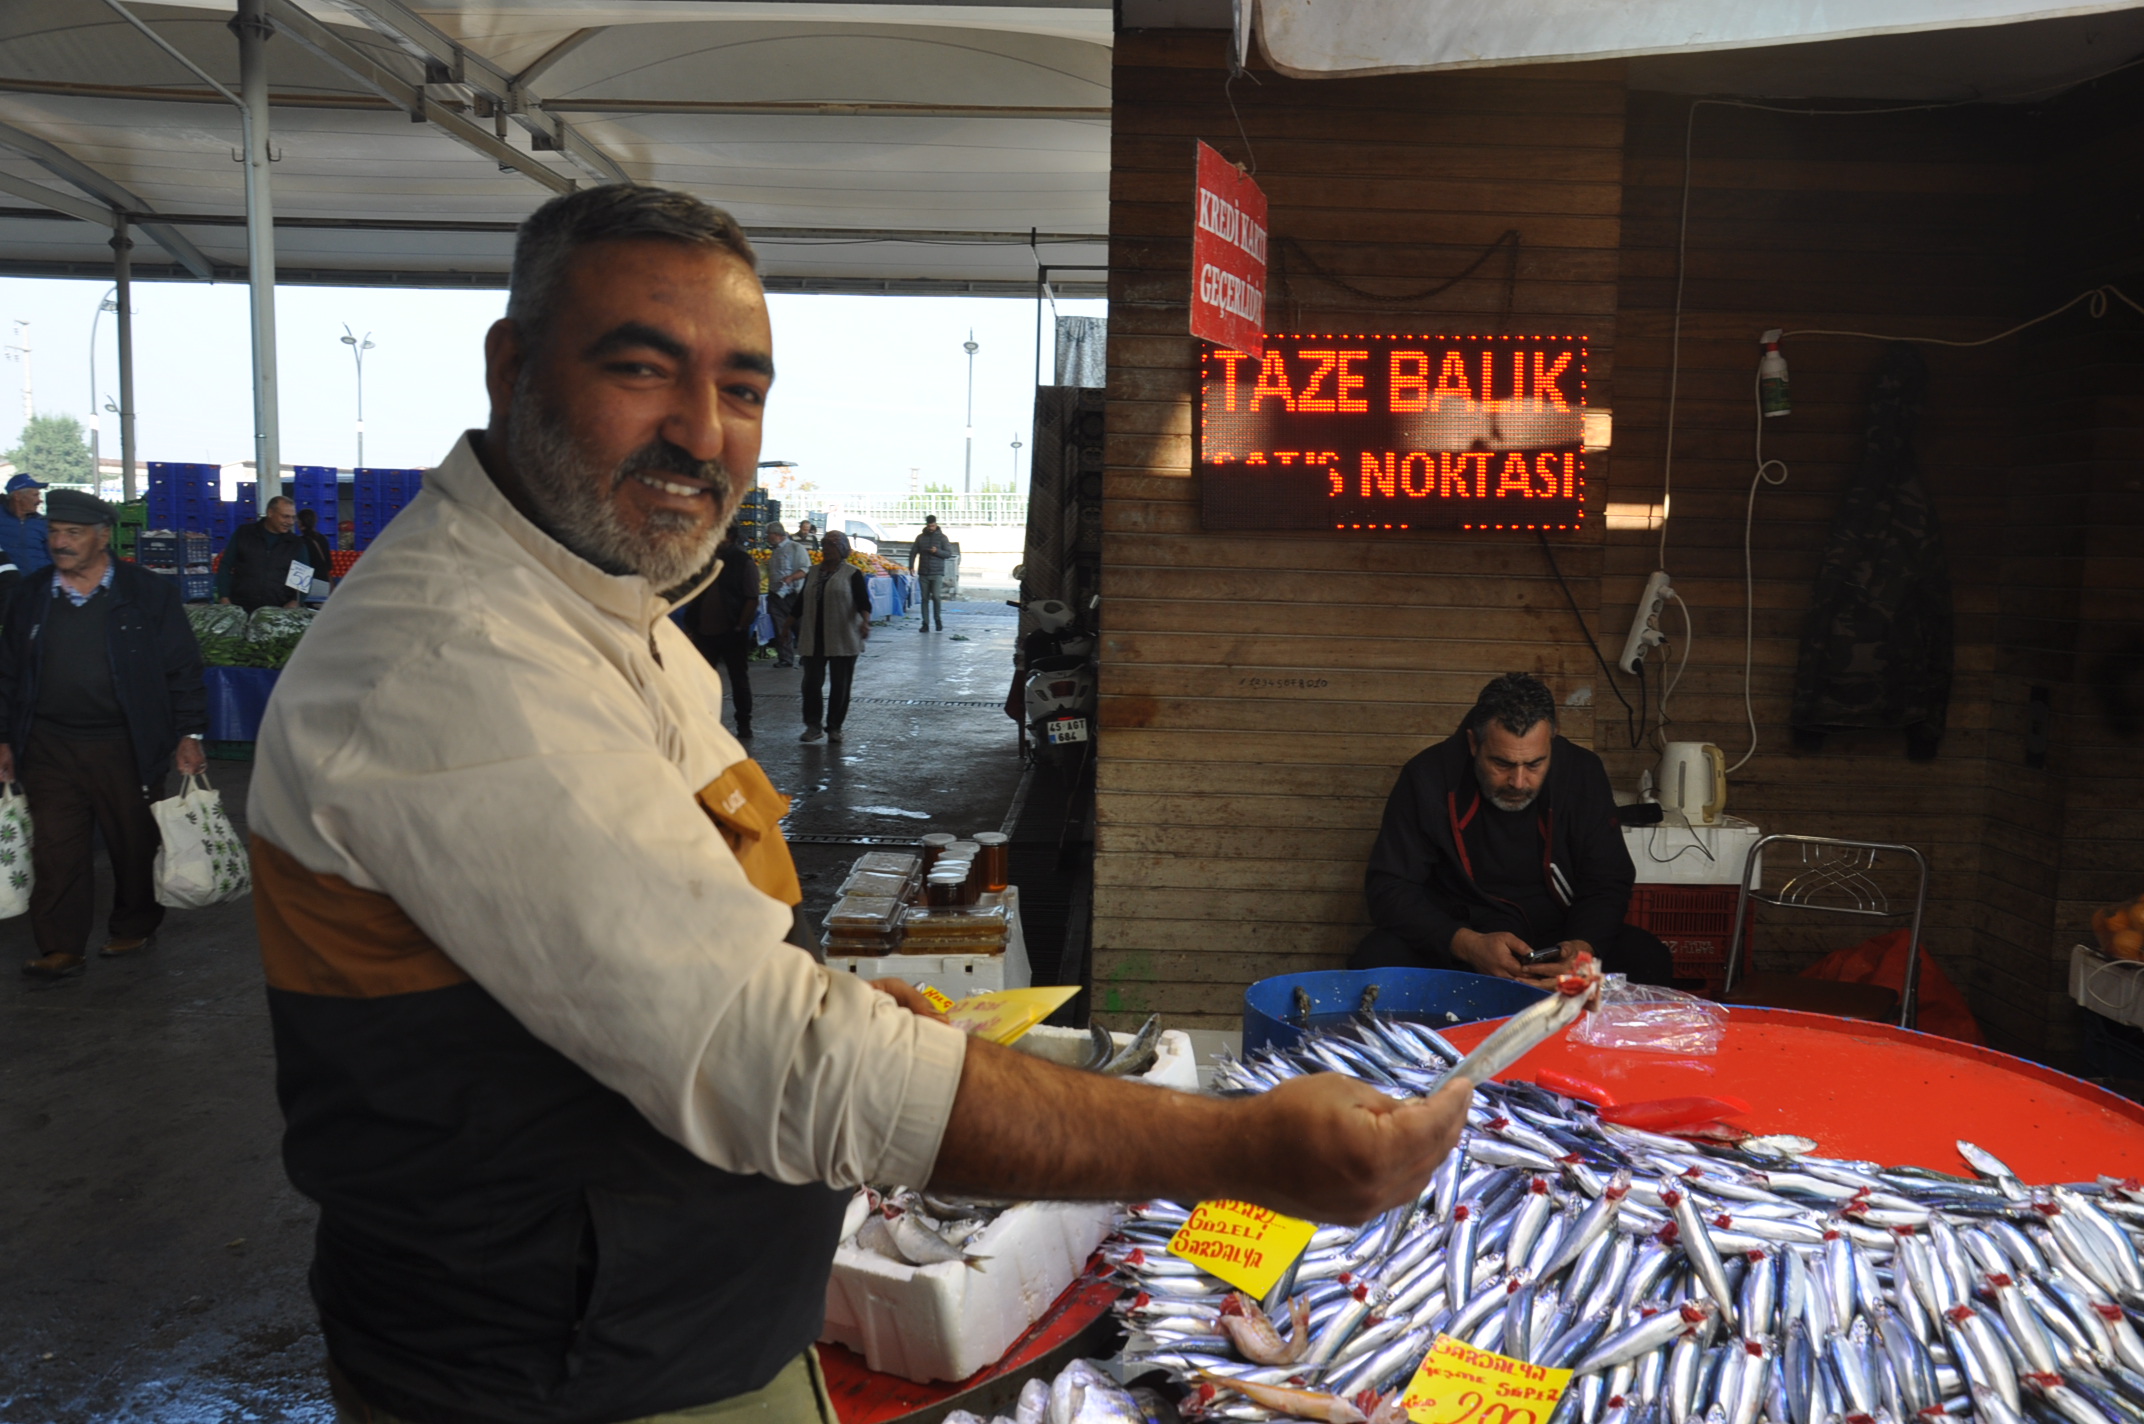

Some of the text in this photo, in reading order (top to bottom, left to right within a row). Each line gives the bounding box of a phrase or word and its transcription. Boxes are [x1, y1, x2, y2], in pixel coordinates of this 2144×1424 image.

[1198, 187, 1240, 247] KREDİ
[1213, 350, 1573, 413] TAZE BALIK
[1360, 451, 1574, 498] NOKTASI
[1050, 720, 1085, 732] 45 AGT
[1058, 732, 1077, 742] 684
